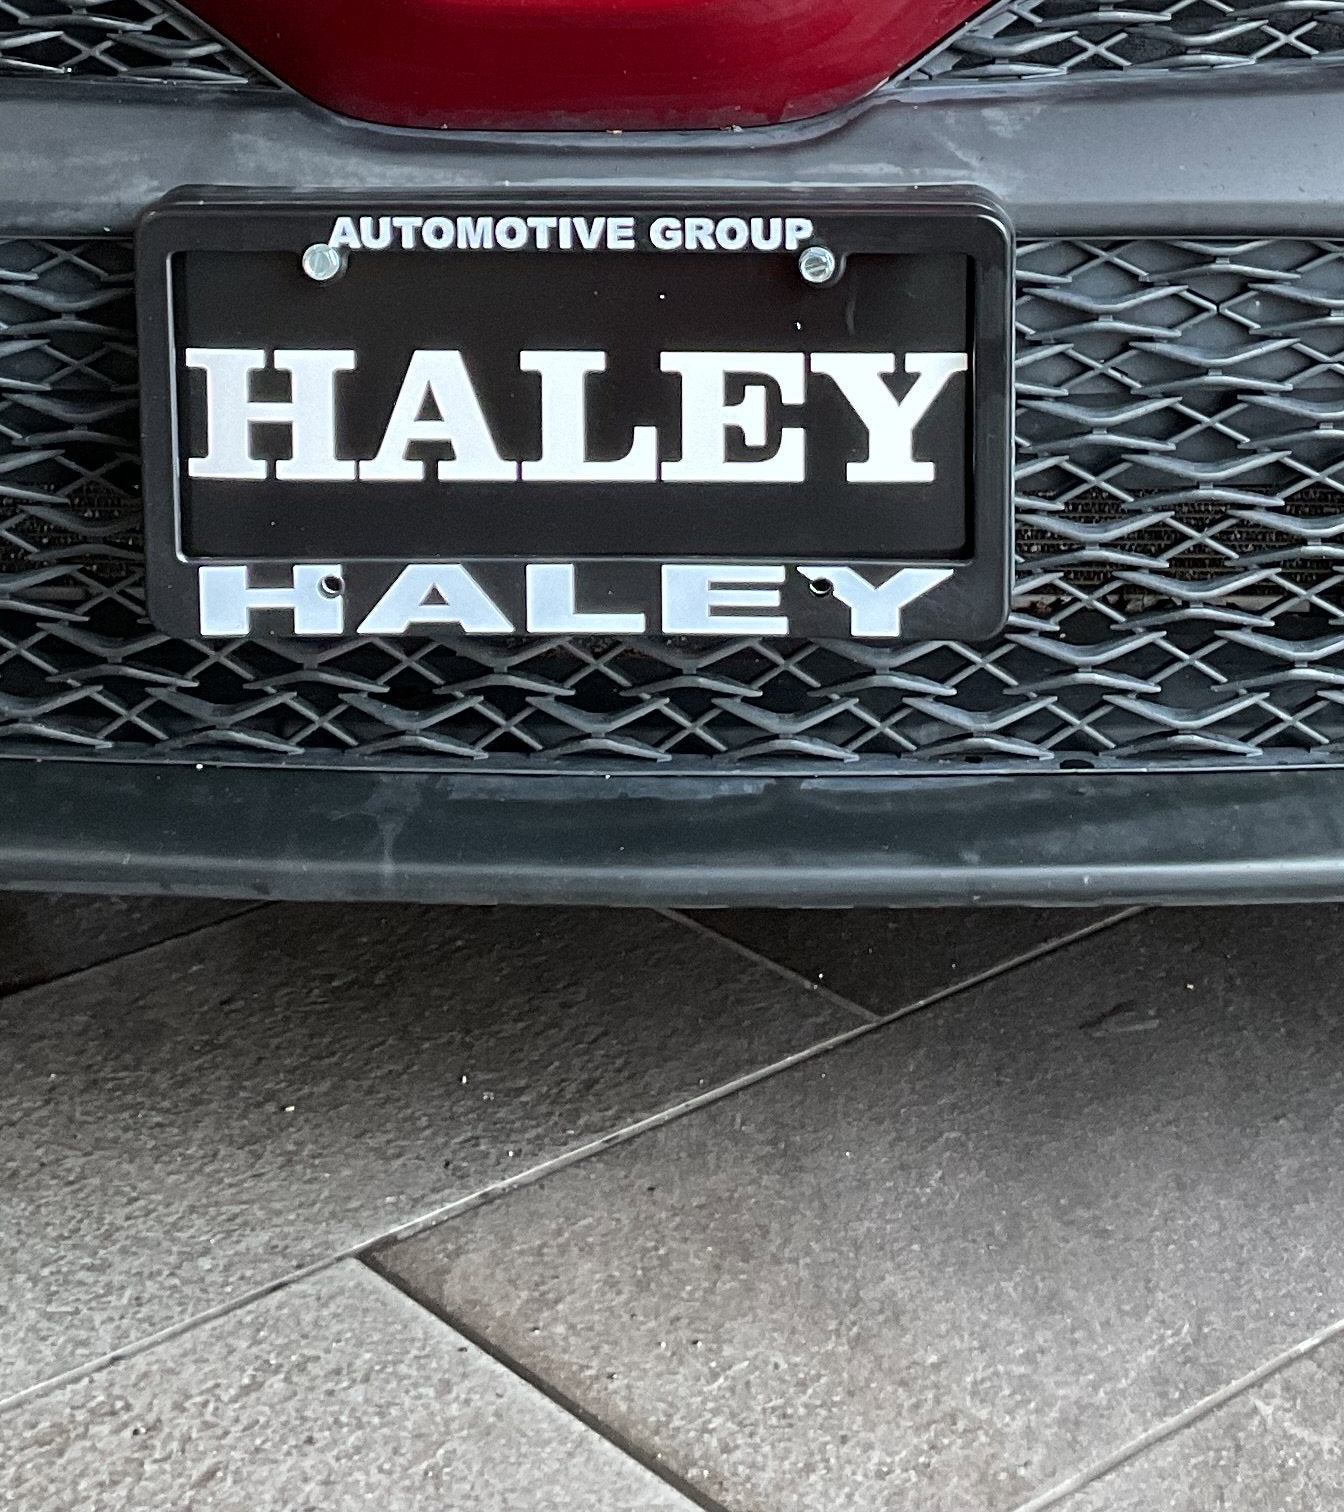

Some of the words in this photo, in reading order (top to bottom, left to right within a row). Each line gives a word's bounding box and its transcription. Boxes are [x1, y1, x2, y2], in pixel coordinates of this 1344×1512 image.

[329, 216, 636, 250] AUTOMOTIVE
[649, 217, 814, 251] GROUP
[185, 347, 968, 483] HALEY
[198, 563, 956, 638] HALEY
